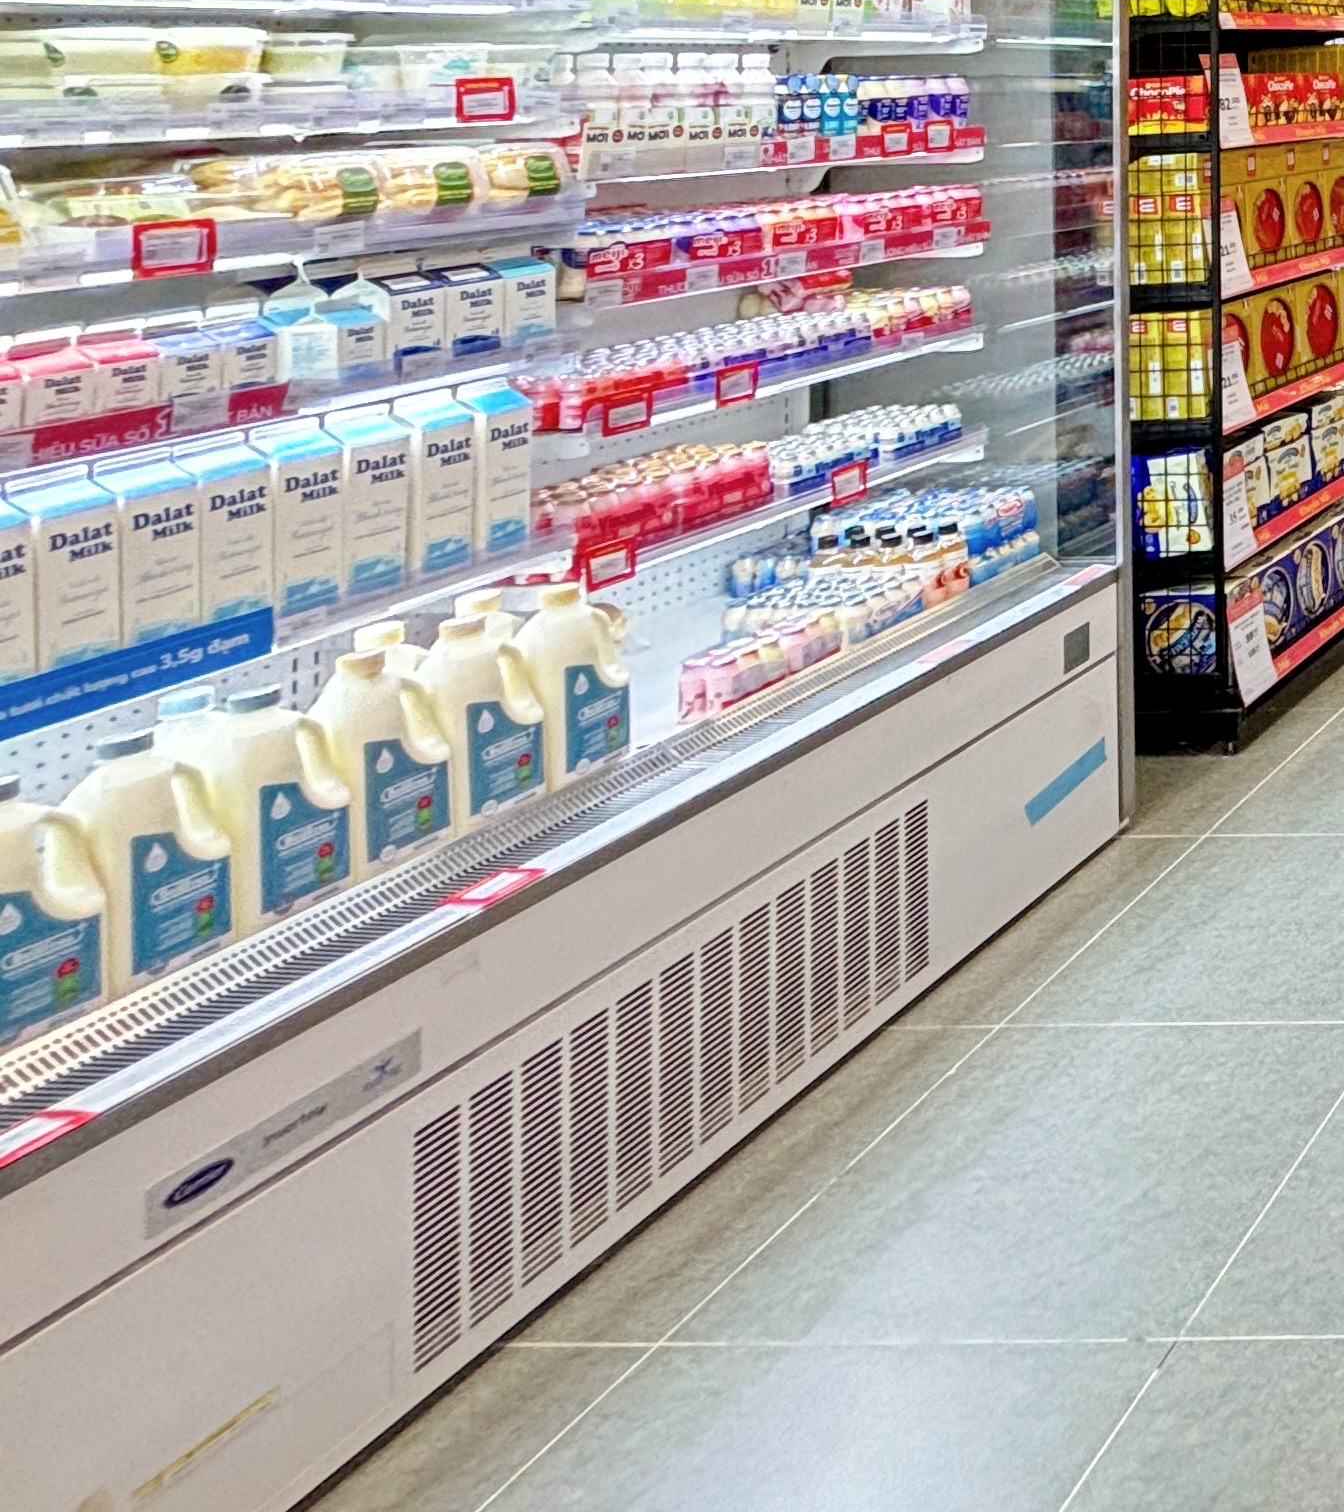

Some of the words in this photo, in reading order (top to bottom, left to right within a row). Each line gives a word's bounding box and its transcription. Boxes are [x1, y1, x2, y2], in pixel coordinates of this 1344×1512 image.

[355, 452, 407, 475] Dalat
[283, 468, 340, 493] Dalat
[209, 485, 268, 512] Dalat
[300, 484, 339, 503] Milk
[132, 503, 196, 532] Dalat
[225, 502, 268, 522] Milk
[48, 522, 114, 553] Dalat
[151, 520, 195, 542] Milk
[68, 539, 114, 563] Milk
